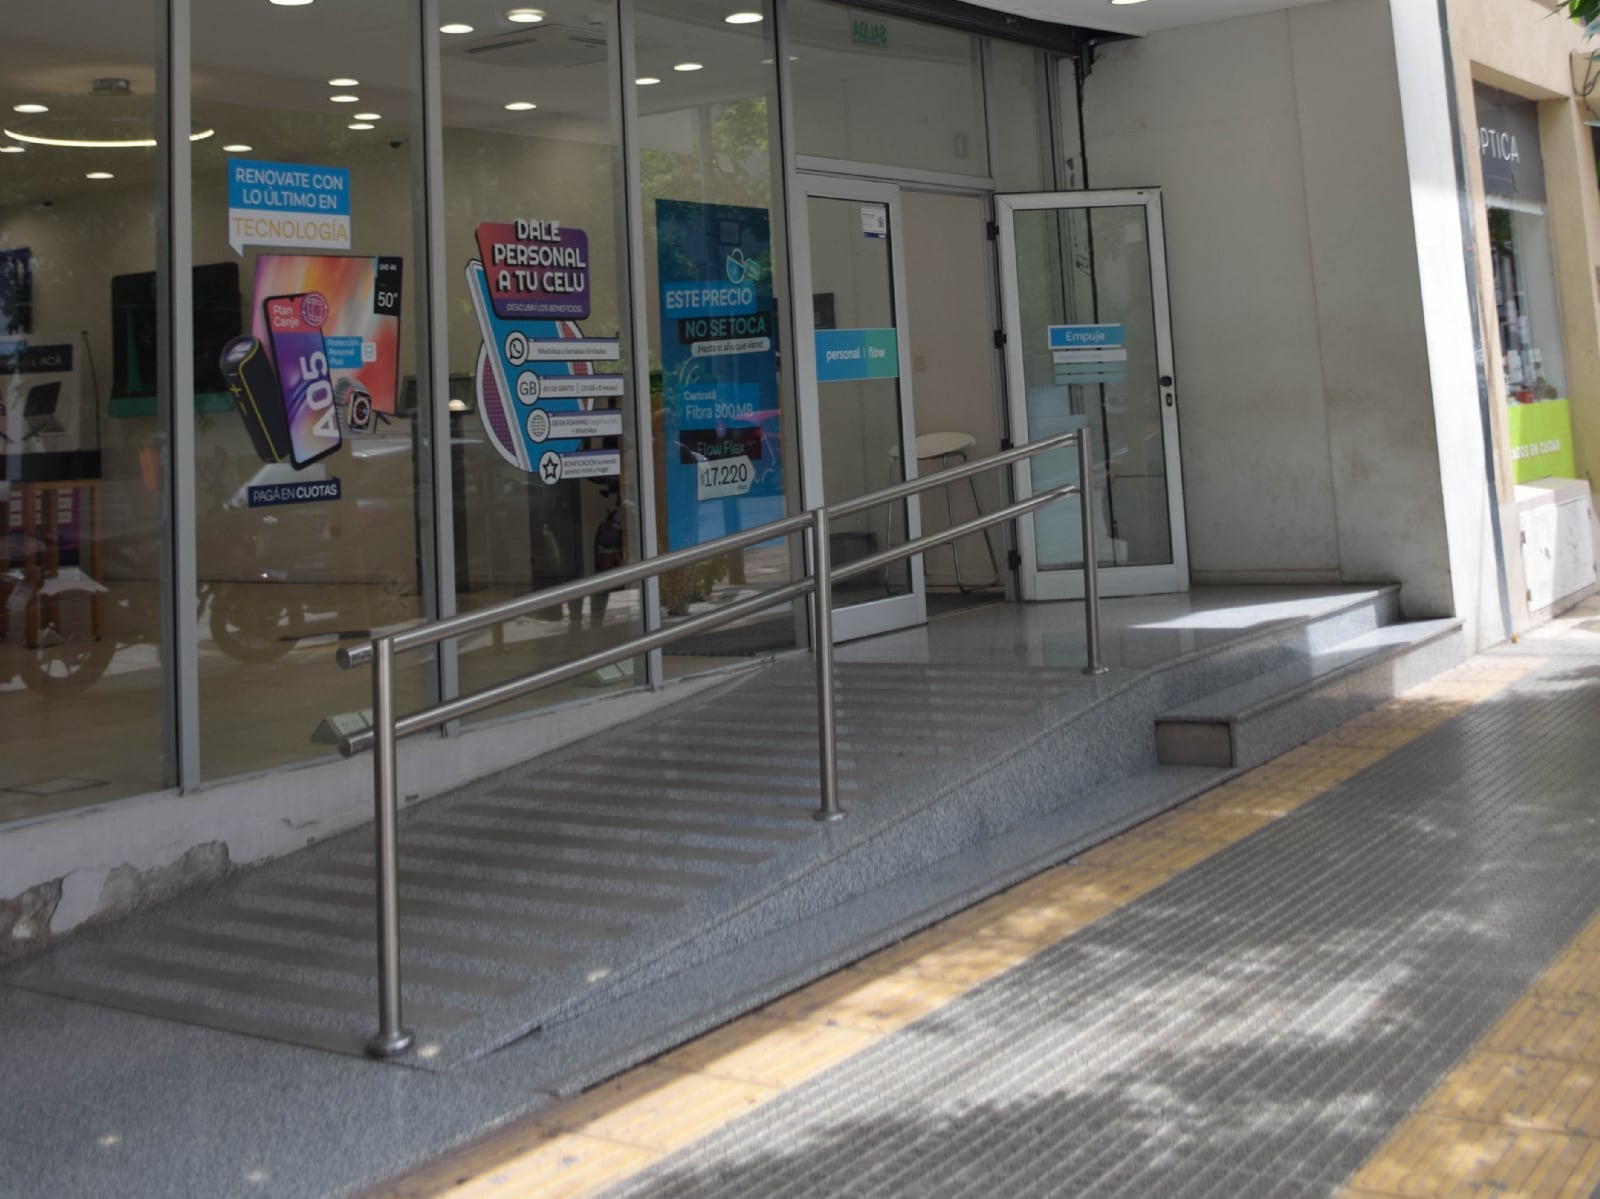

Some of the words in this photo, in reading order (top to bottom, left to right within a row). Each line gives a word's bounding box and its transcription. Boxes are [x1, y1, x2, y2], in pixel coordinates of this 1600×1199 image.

[1479, 127, 1520, 163] PTICA
[235, 167, 310, 190] RENOVATE
[312, 174, 344, 191] CON
[242, 188, 263, 205] LO
[264, 186, 317, 209] ÚLTIMO
[319, 193, 338, 210] EN
[233, 216, 348, 242] TECNOLOGÍA
[515, 218, 561, 242] DALE
[494, 243, 586, 268] PERSONAL
[499, 270, 512, 292] A
[515, 270, 538, 293] TU
[543, 271, 586, 293] CELU
[666, 290, 700, 309] ESTE
[701, 288, 753, 307] PRECIO
[272, 304, 294, 315] Plan
[273, 316, 300, 329] Canje
[685, 320, 708, 339] NO
[710, 319, 728, 337] SE
[730, 316, 767, 335] TOCA
[1064, 330, 1105, 343] Empuje
[826, 346, 861, 363] personal
[868, 345, 886, 358] flow
[519, 381, 537, 397] GB
[685, 404, 713, 420] Fibra
[714, 403, 736, 418] 300
[736, 403, 754, 417] MB
[696, 441, 722, 456] Flow
[723, 440, 745, 455] Flex
[253, 486, 281, 503] PAGÁ
[281, 486, 296, 501] EN
[296, 483, 338, 499] CUOTAS
